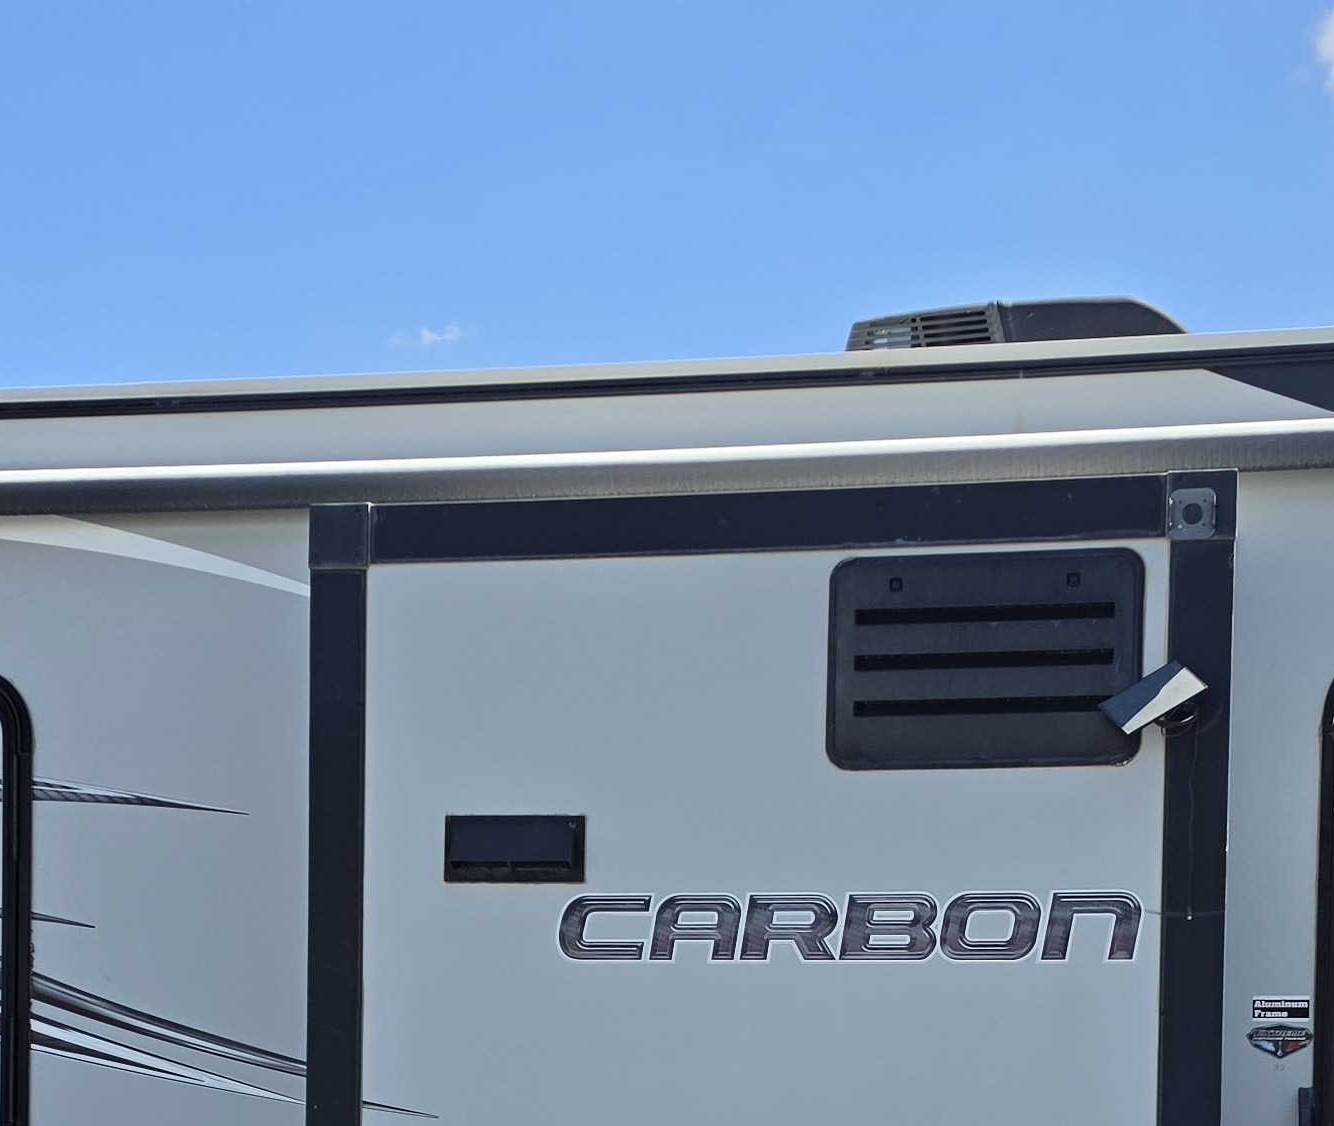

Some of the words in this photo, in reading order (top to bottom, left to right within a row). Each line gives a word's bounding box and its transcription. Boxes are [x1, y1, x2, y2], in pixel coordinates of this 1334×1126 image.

[558, 890, 1144, 963] CARBON
[1254, 1000, 1308, 1009] Aluminum
[1254, 1010, 1288, 1018] Frame
